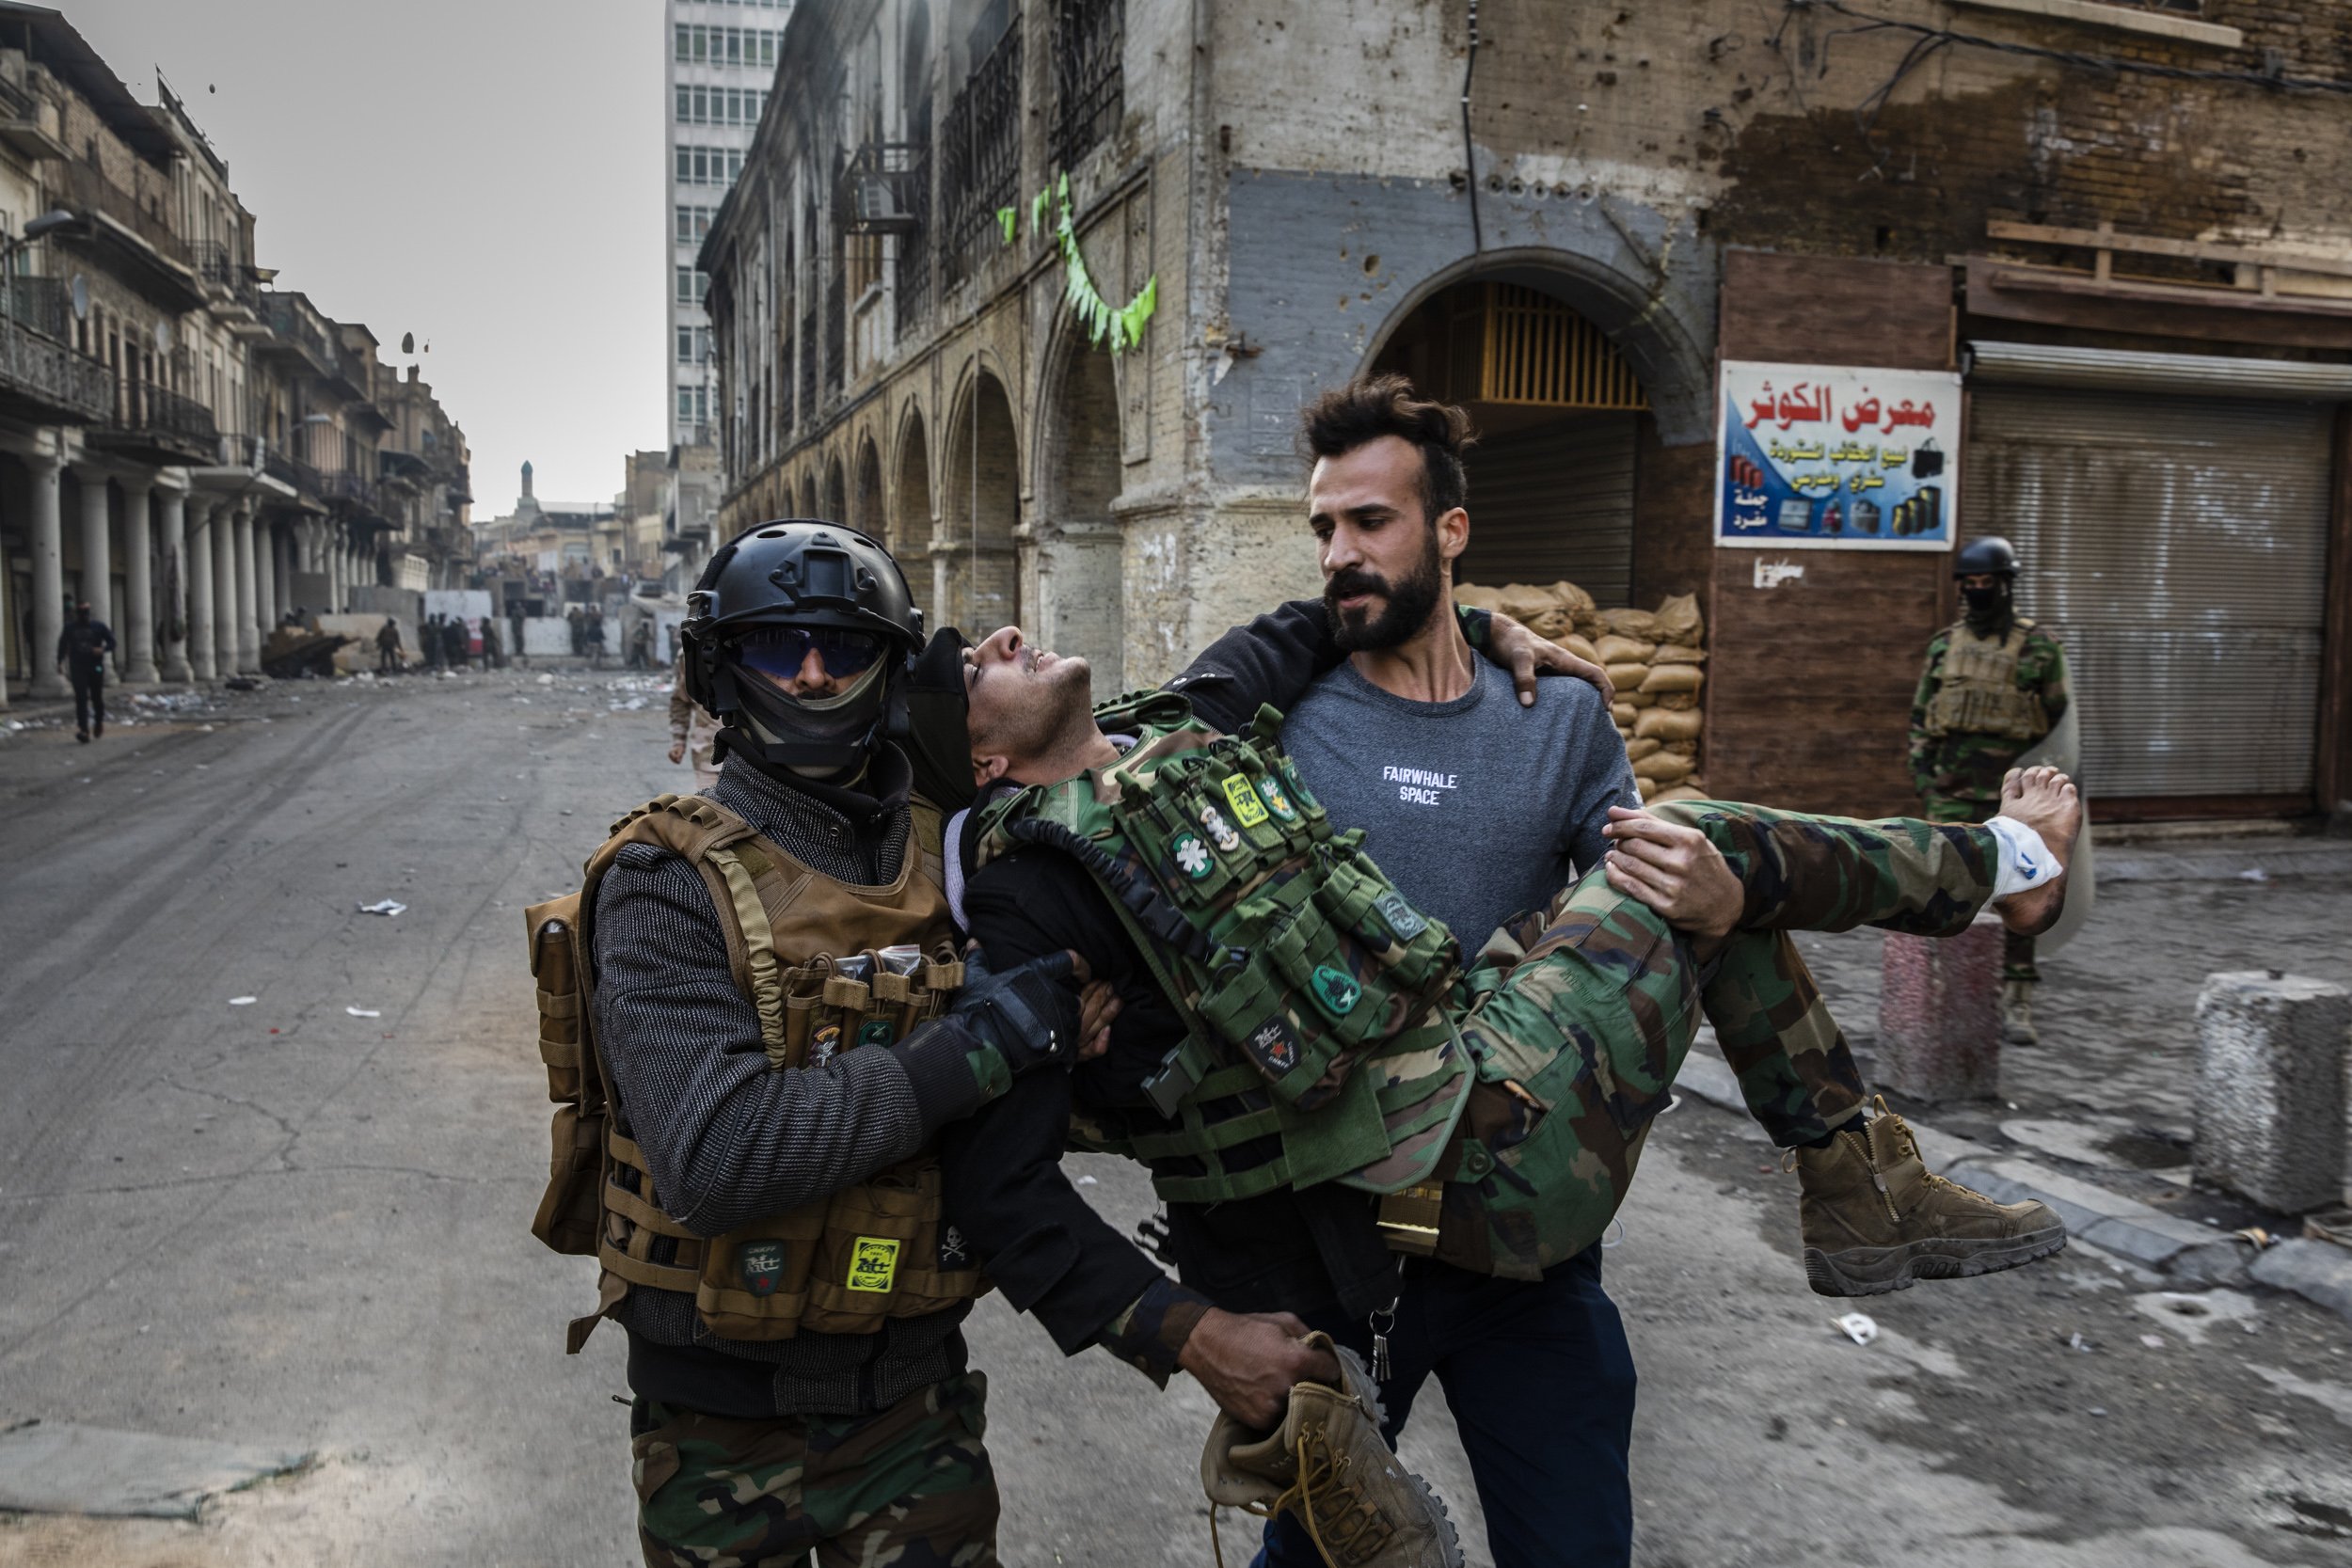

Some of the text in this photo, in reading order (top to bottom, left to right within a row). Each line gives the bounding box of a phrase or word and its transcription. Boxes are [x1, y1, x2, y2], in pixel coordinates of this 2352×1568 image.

[1743, 380, 1936, 435] معرض الكوثر
[1770, 438, 1908, 469] لبيع الحقائب المستوردة
[1733, 488, 1769, 510] جملة
[1733, 510, 1768, 531] مفرد
[1383, 766, 1457, 788] FAIRWHALE
[1400, 785, 1440, 805] SPACE
